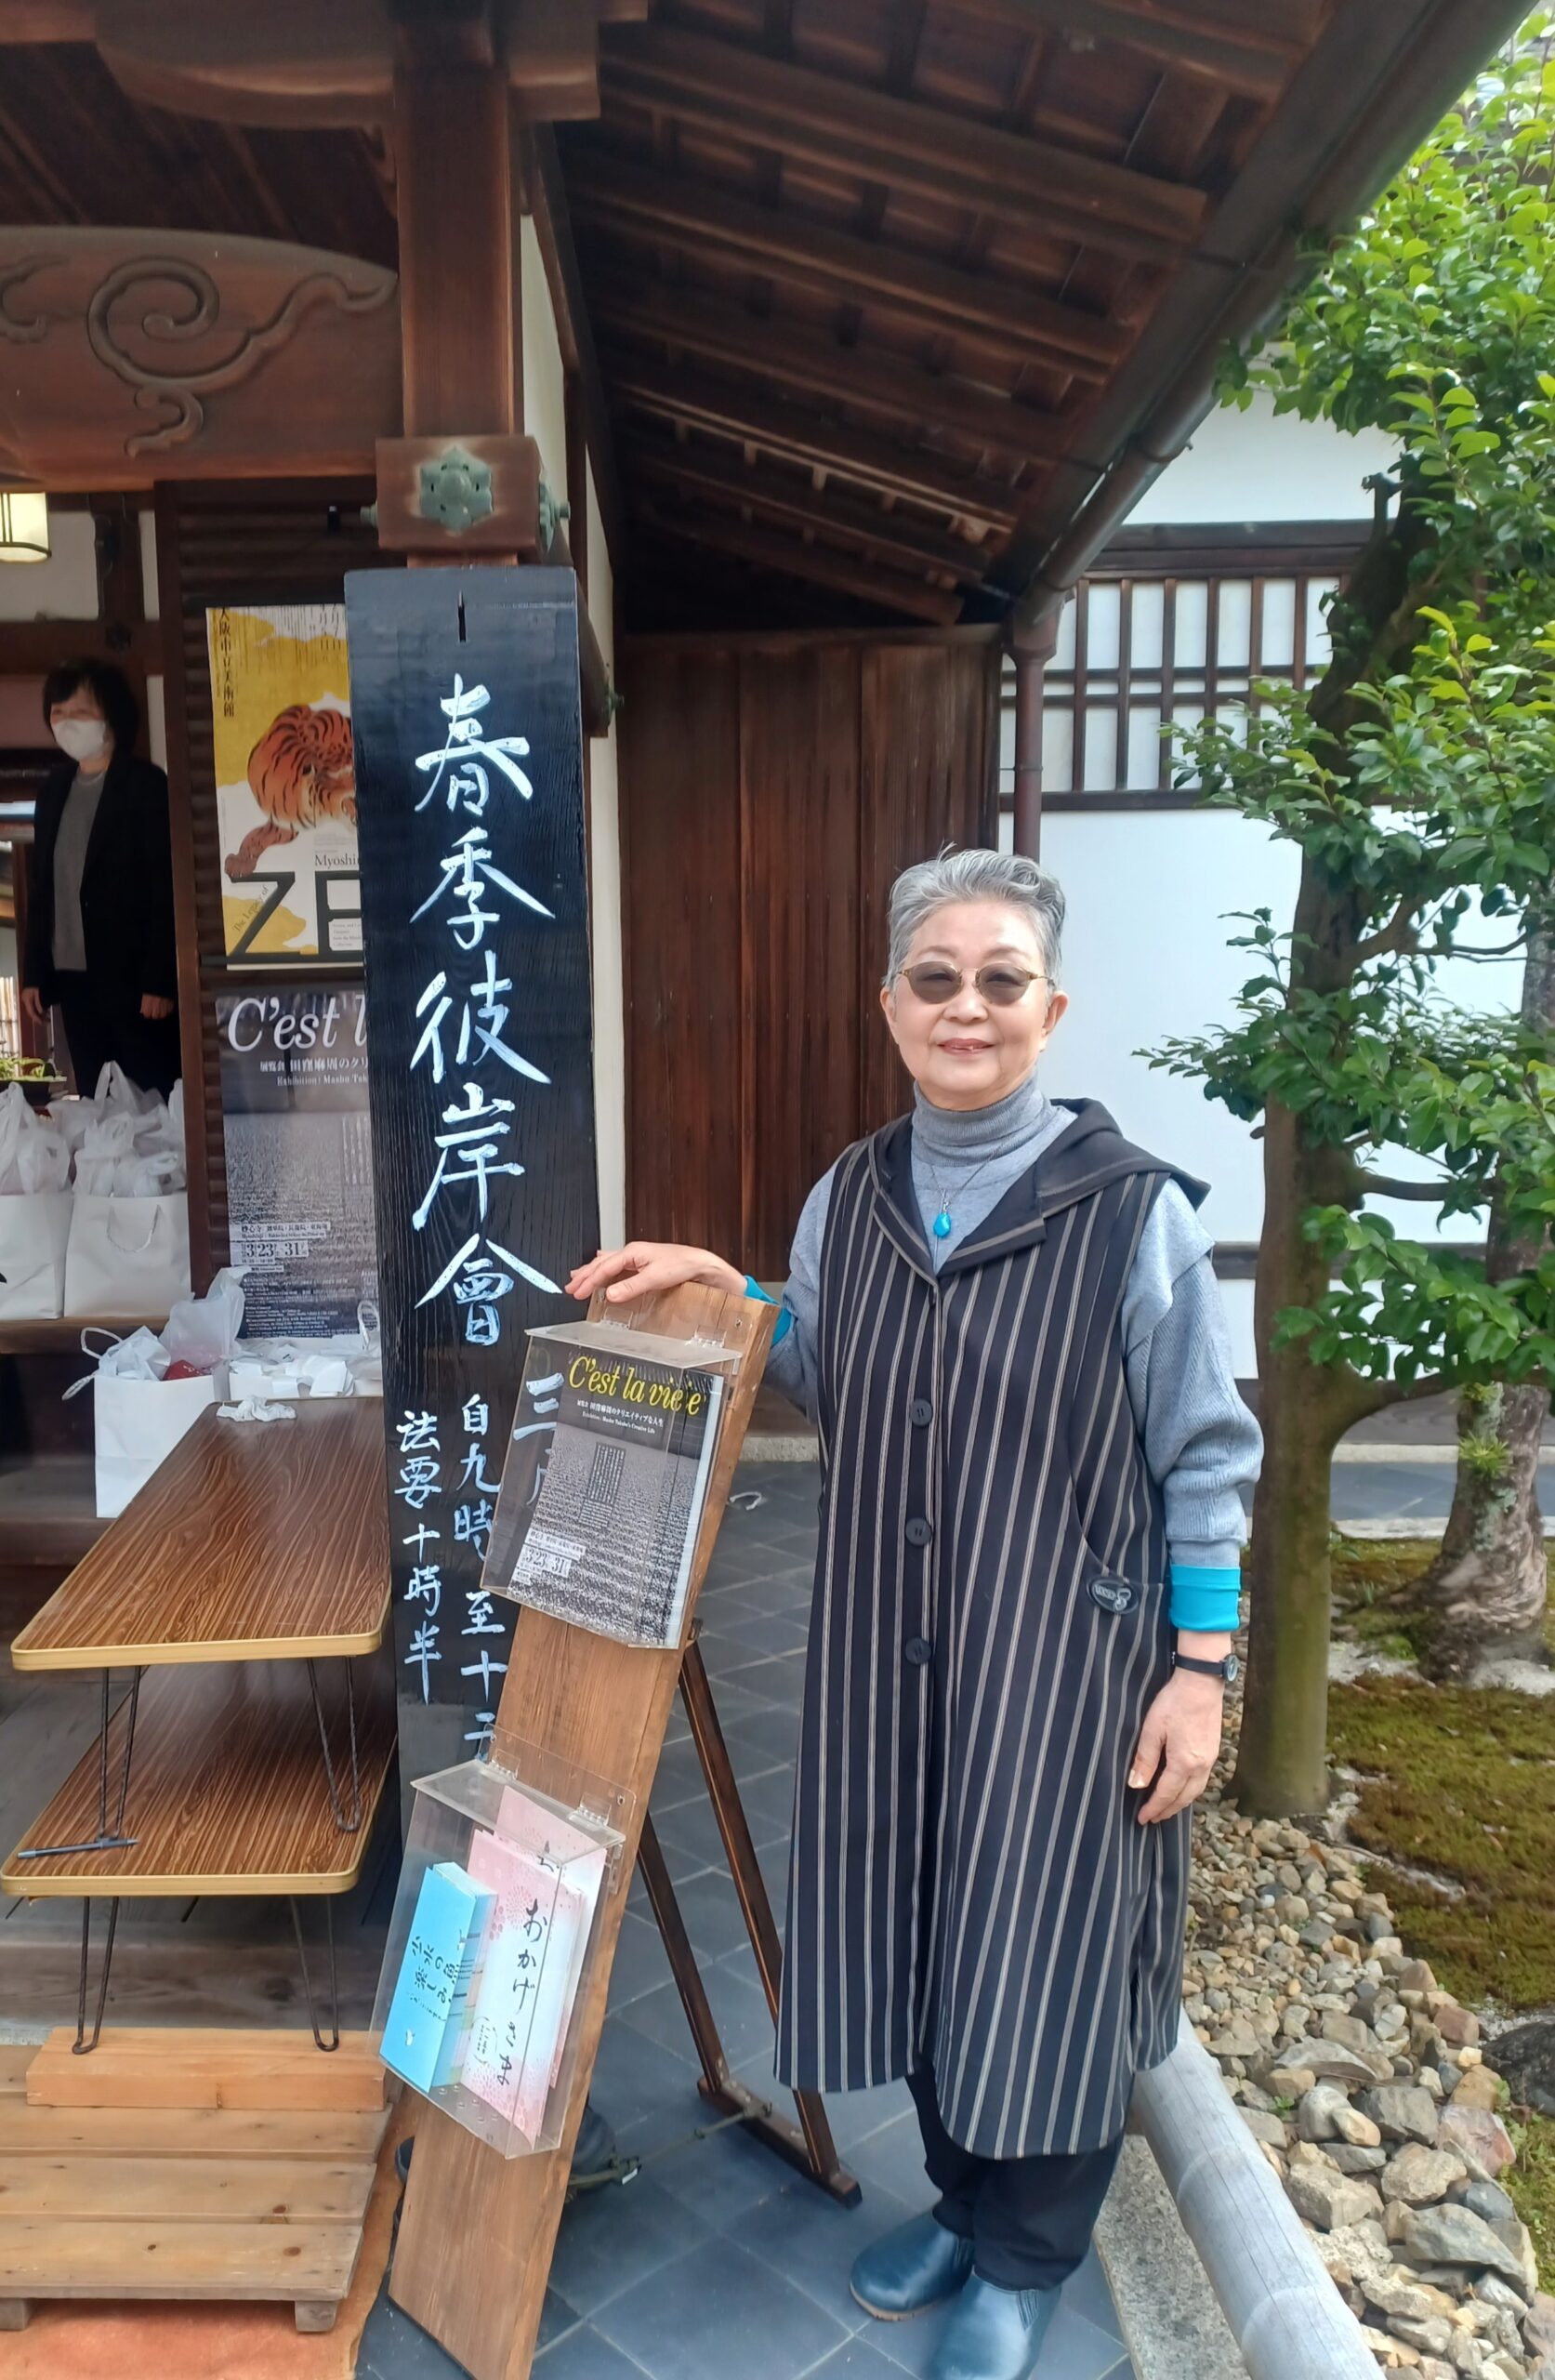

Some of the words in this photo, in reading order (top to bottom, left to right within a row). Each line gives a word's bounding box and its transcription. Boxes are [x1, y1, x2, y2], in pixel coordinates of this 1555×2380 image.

[496, 1897, 548, 2085] おかげさま
